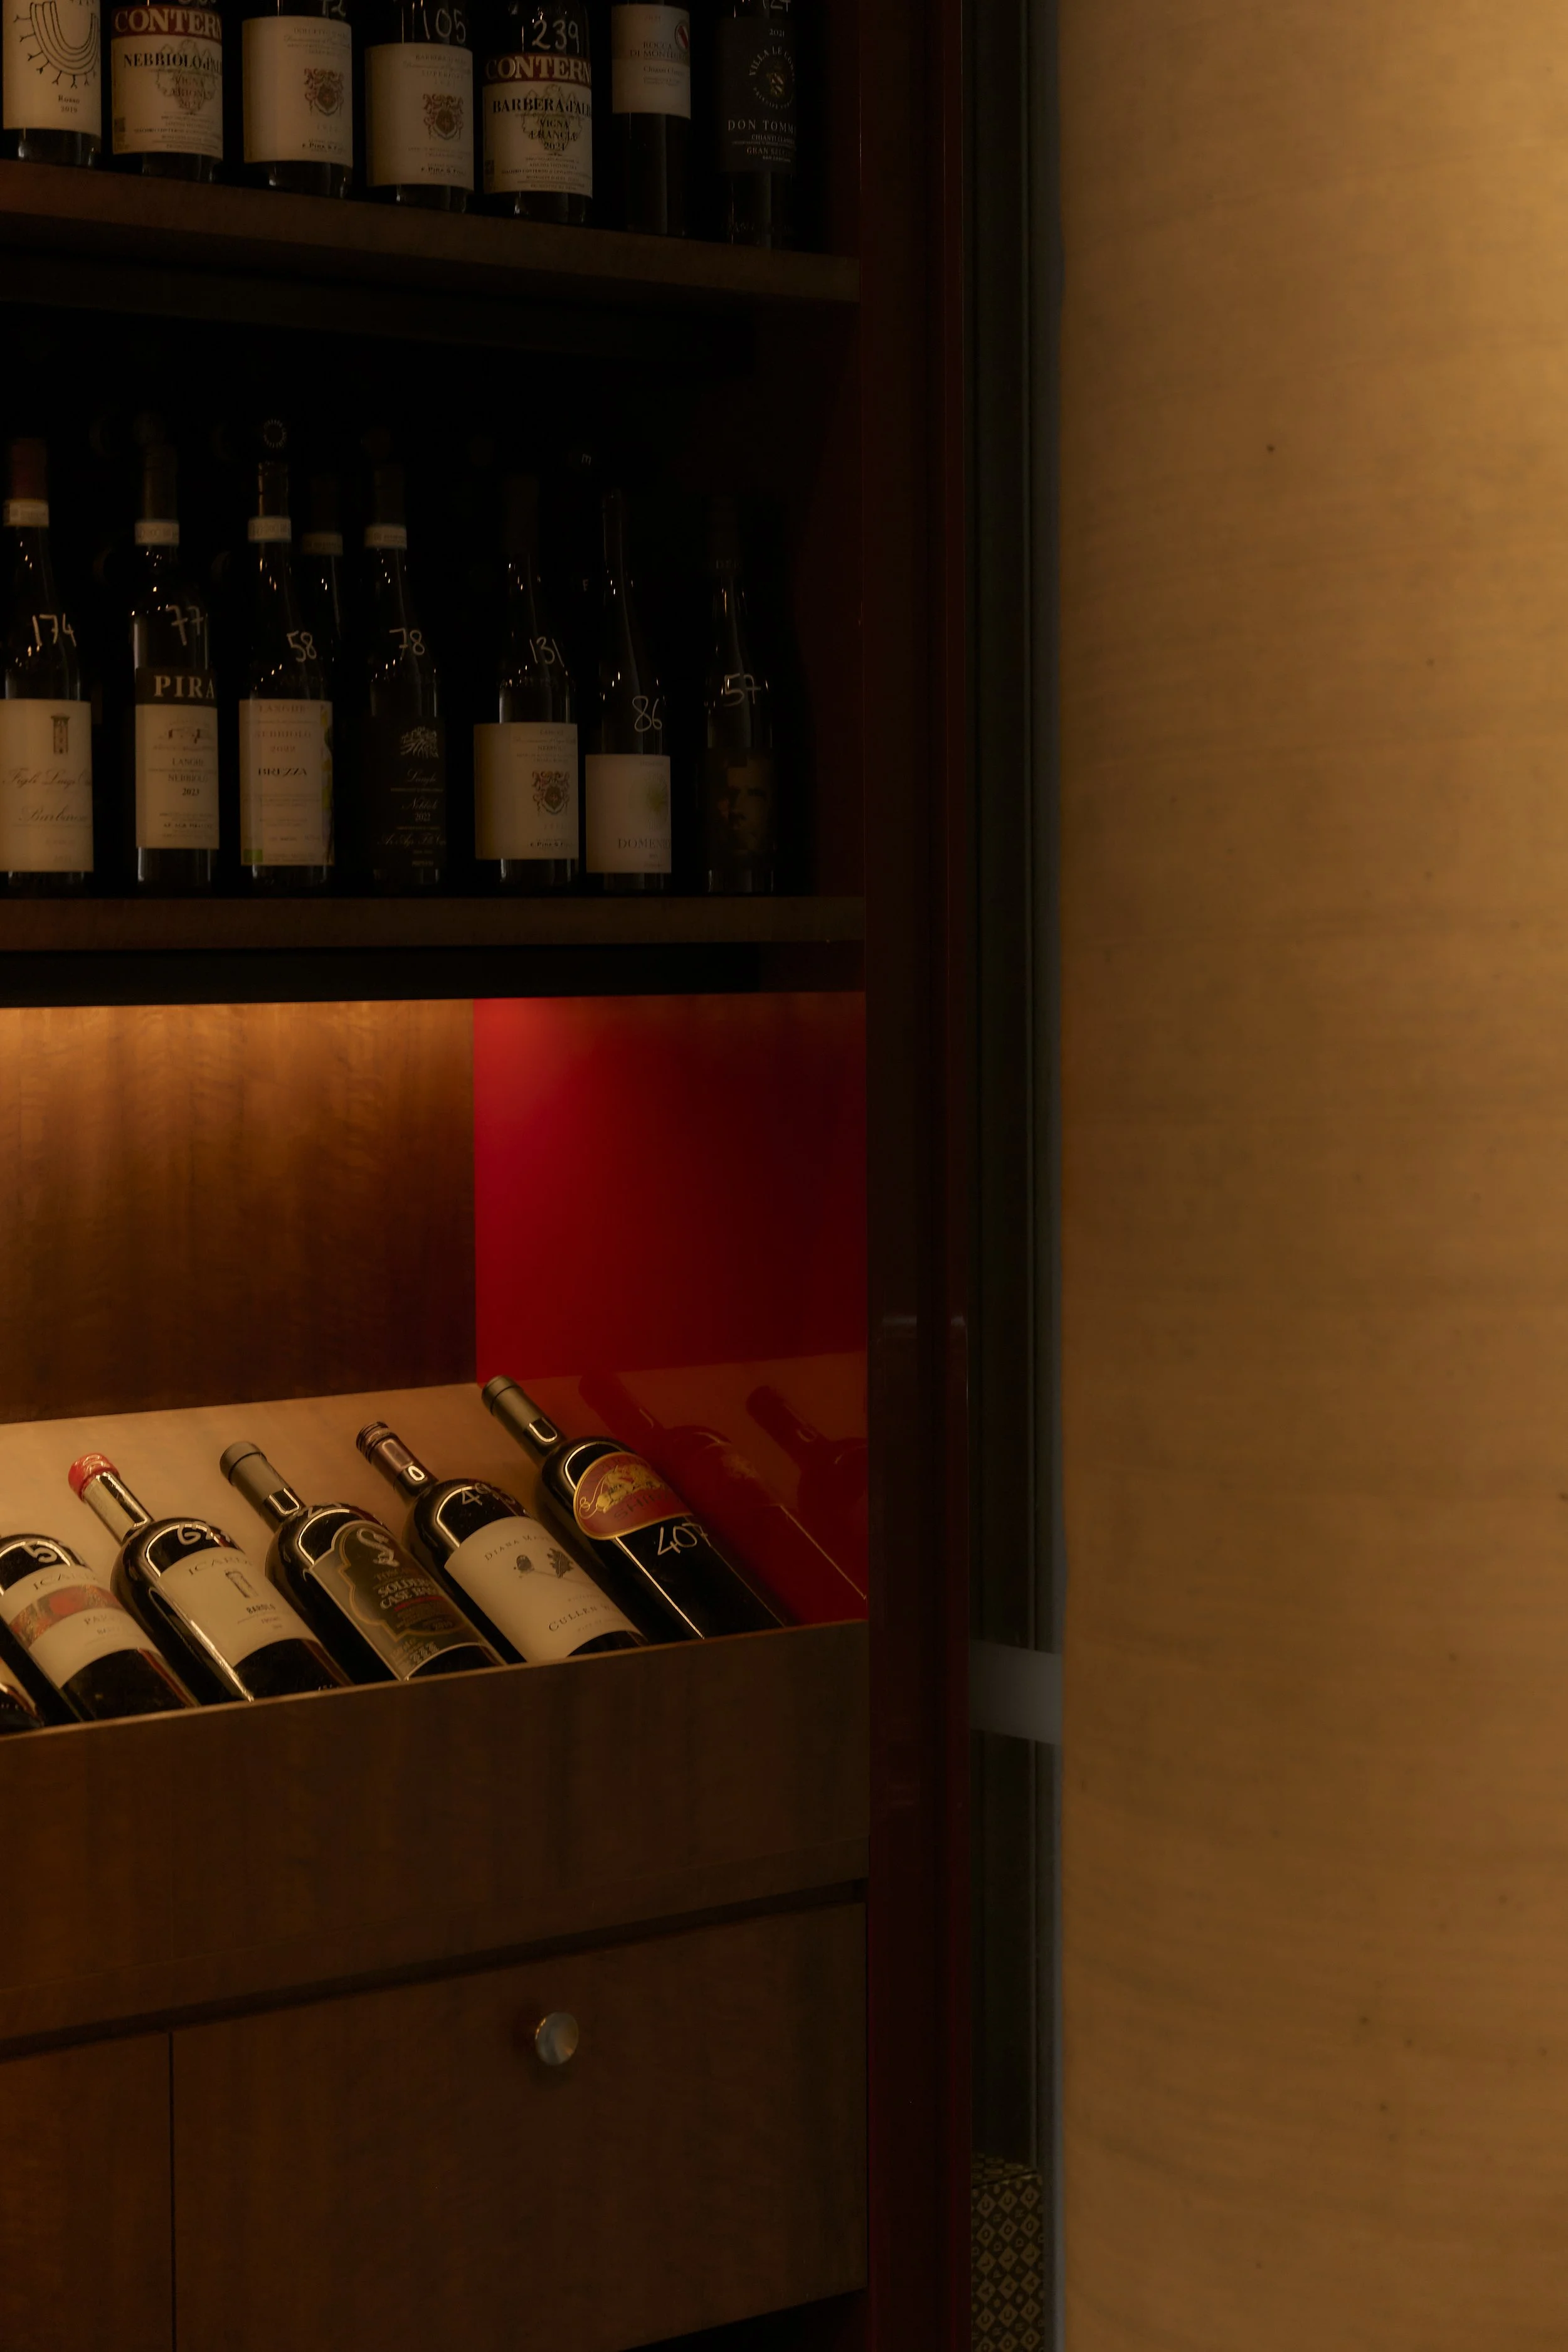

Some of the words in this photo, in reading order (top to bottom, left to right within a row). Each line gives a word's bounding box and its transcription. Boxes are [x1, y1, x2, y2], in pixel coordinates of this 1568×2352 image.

[532, 19, 580, 54] 239
[727, 119, 757, 132] DON
[32, 612, 77, 648] 174
[286, 630, 317, 663] 58
[389, 627, 426, 662] 78
[154, 674, 215, 699] PIRA
[632, 695, 663, 733] 86
[258, 768, 308, 777] BREZZA
[658, 1521, 709, 1556] 407
[548, 1605, 598, 1632] CULLEN
